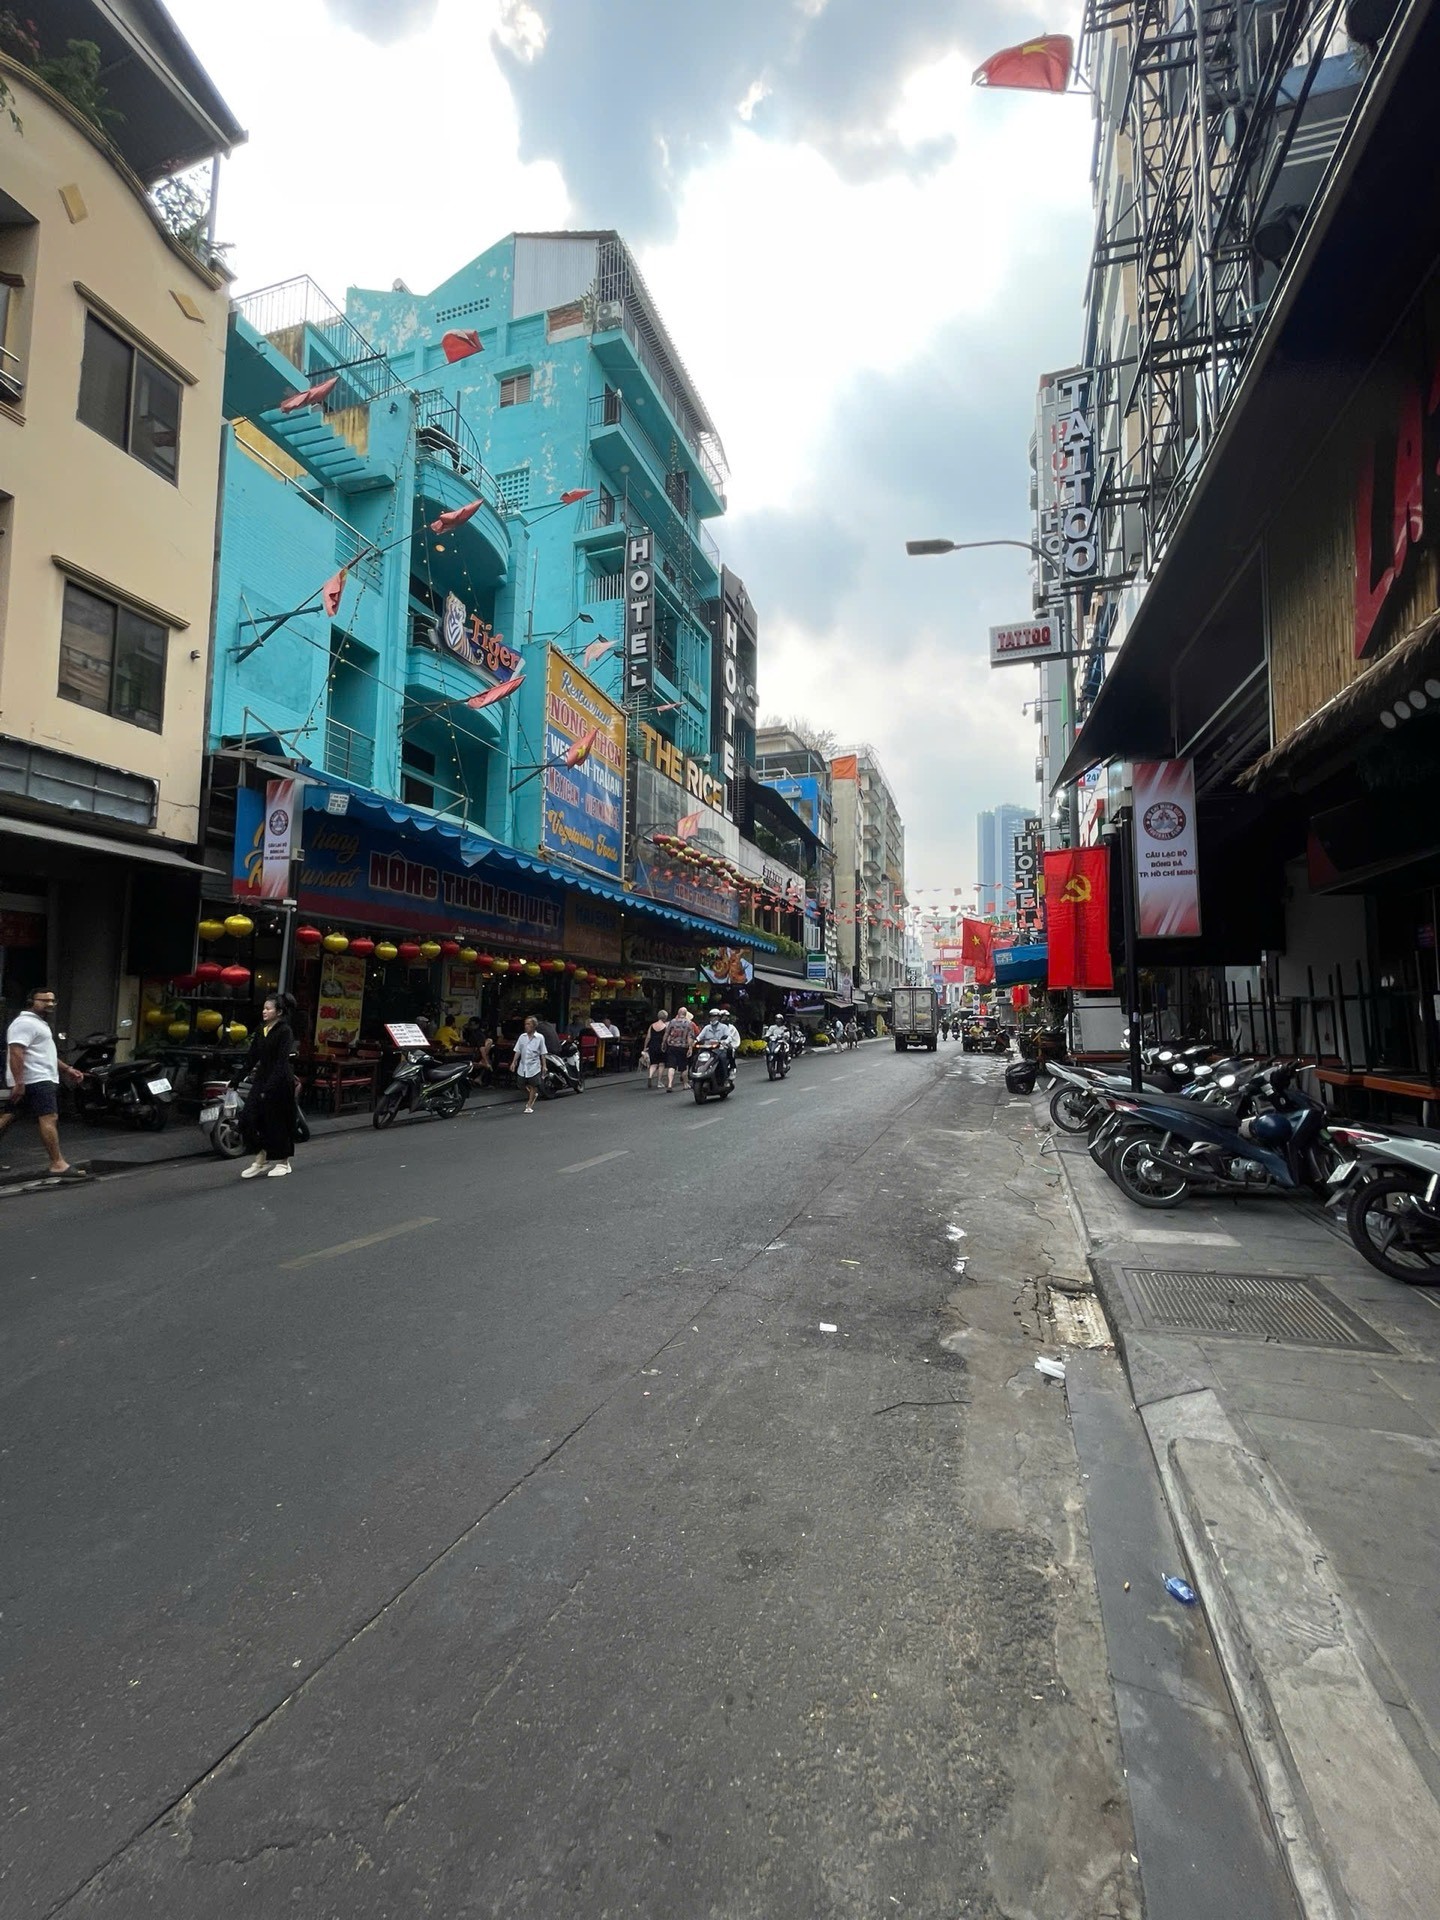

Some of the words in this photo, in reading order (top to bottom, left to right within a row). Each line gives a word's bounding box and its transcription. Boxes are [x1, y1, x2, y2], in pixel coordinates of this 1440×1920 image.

[1062, 377, 1096, 573] TATTOO
[630, 538, 650, 687] HOTEL
[998, 626, 1051, 648] TATTOO
[470, 613, 520, 672] Tiger
[549, 691, 588, 739] NÔNG
[561, 670, 614, 727] Restauran
[724, 612, 737, 822] HOTEL
[548, 766, 580, 808] MEXICAN
[640, 721, 683, 785] THE
[686, 757, 723, 813] RICE
[548, 809, 594, 851] Vegetarian
[596, 833, 618, 862] Foods
[1145, 850, 1161, 859] CÂU
[1177, 849, 1188, 858] BỘ
[368, 849, 440, 901] NÔNG
[441, 870, 496, 914] THÔN
[1162, 869, 1176, 877] CHÍ
